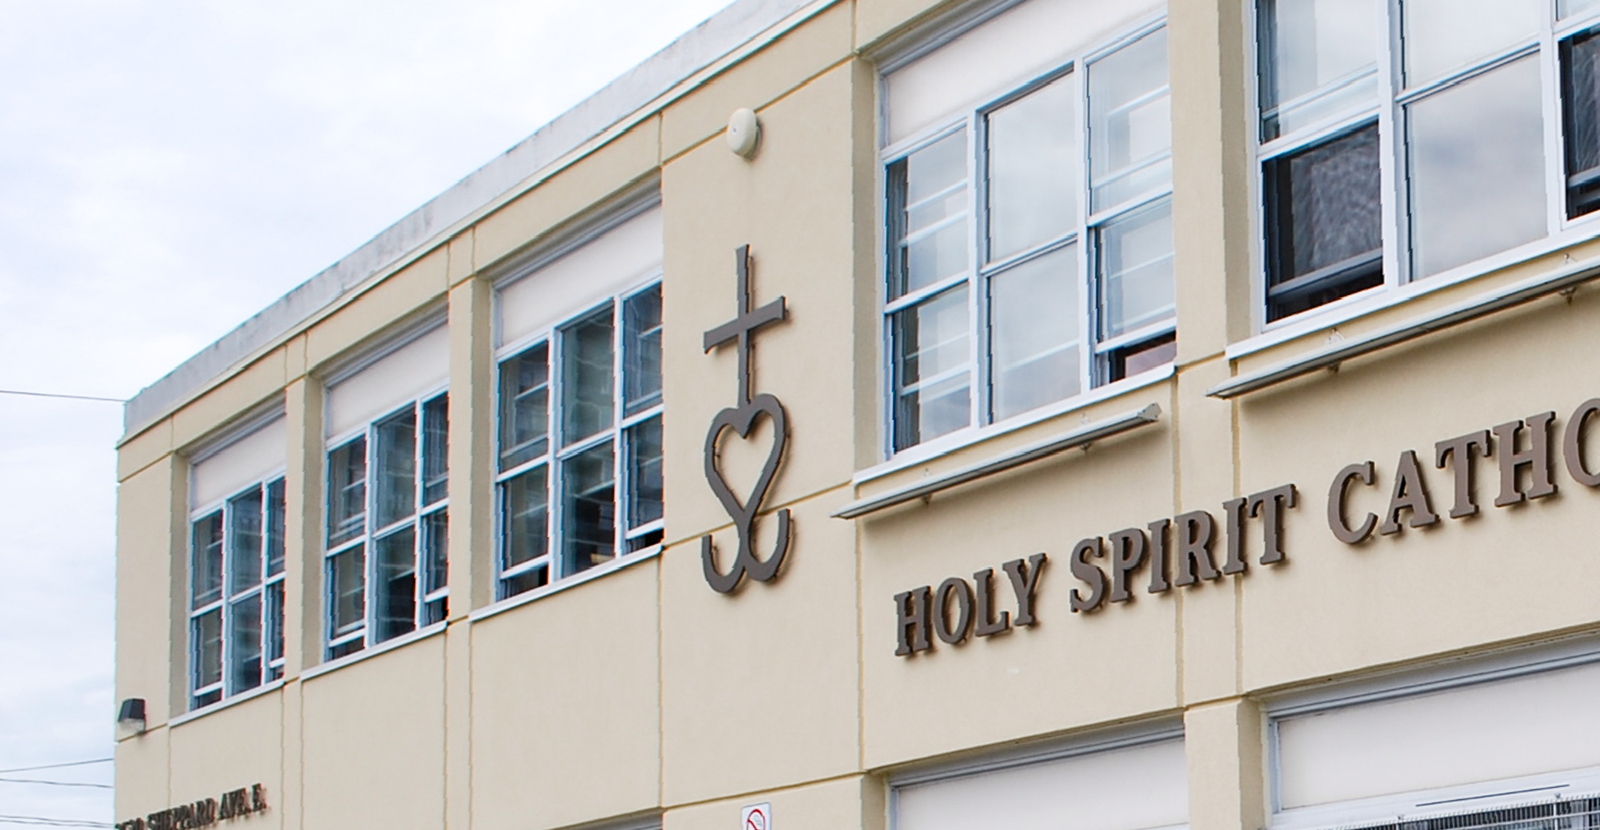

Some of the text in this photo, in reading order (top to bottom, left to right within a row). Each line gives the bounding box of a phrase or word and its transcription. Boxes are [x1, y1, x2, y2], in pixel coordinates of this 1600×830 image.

[894, 552, 1047, 656] HOLY
[1070, 484, 1297, 613] SPIRIT
[147, 798, 216, 830] SHEPPARD
